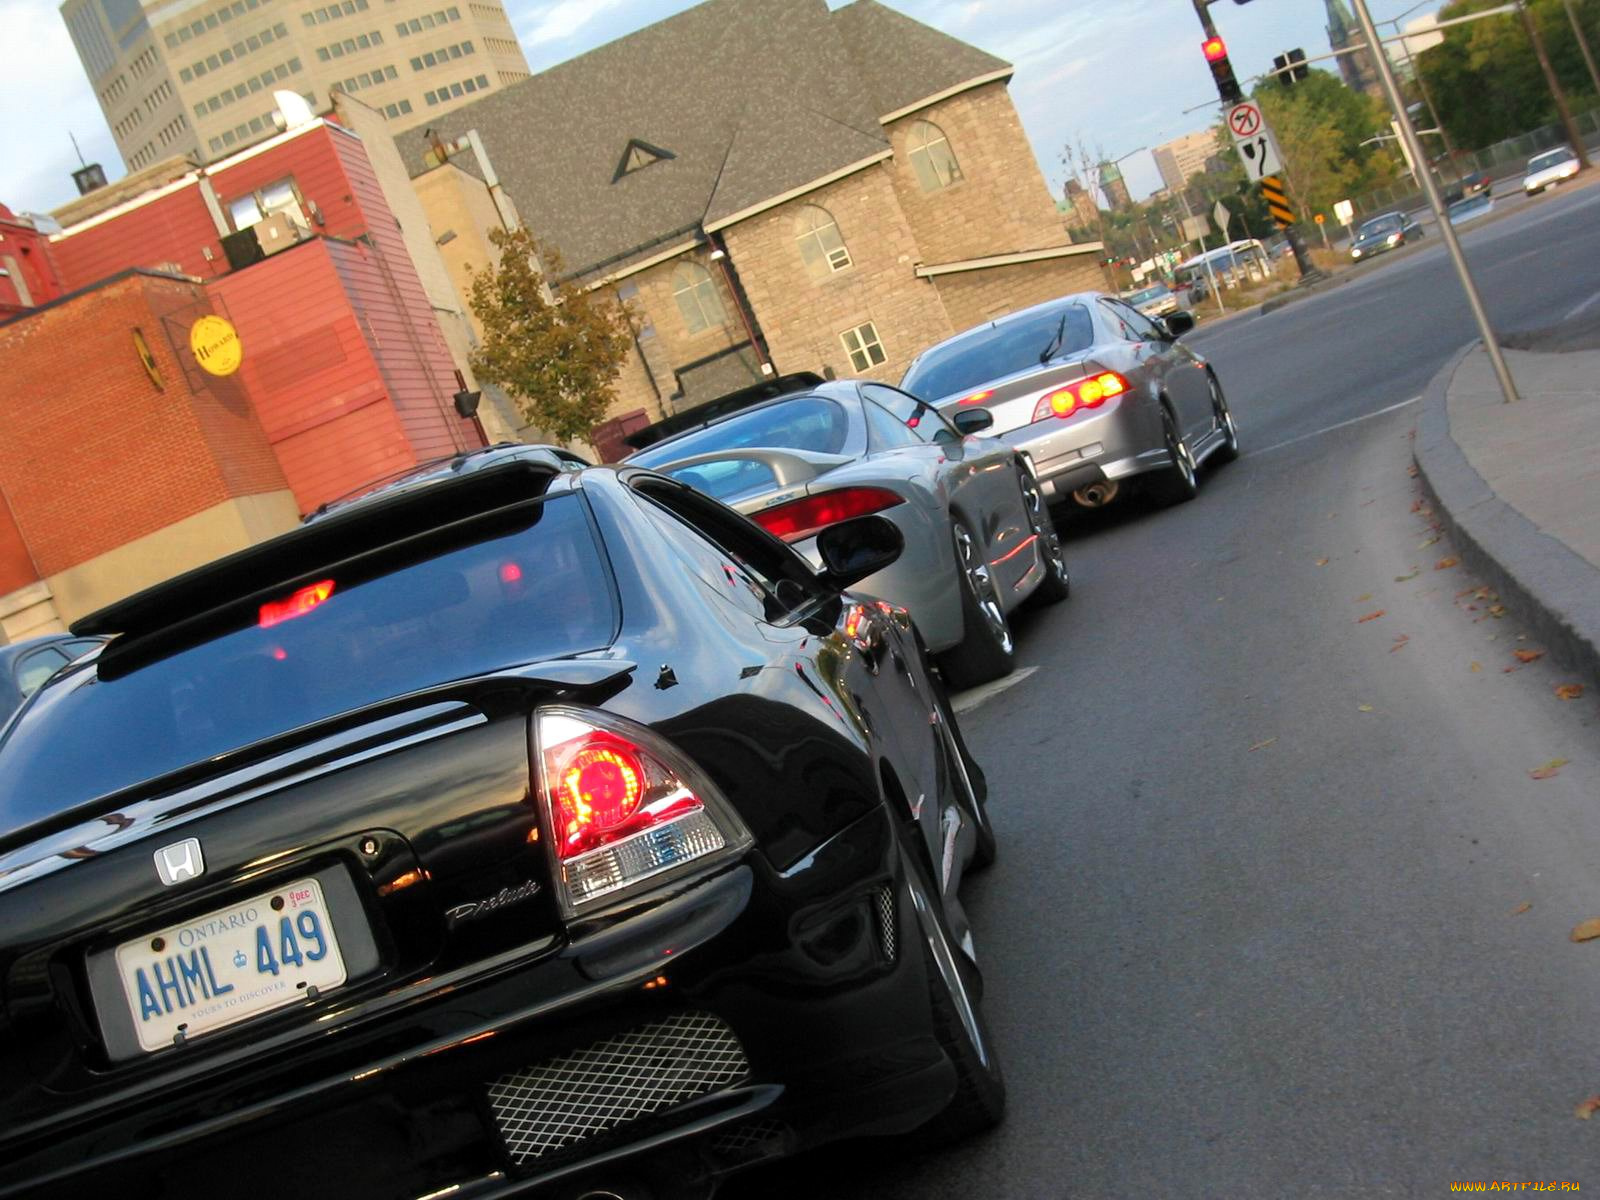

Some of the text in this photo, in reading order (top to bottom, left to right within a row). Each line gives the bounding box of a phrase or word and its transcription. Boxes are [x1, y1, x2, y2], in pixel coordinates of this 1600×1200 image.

[178, 908, 258, 947] ONTARIO
[136, 910, 327, 1021] AHML 449
[192, 981, 287, 1019] YOURS TO DISCOVER
